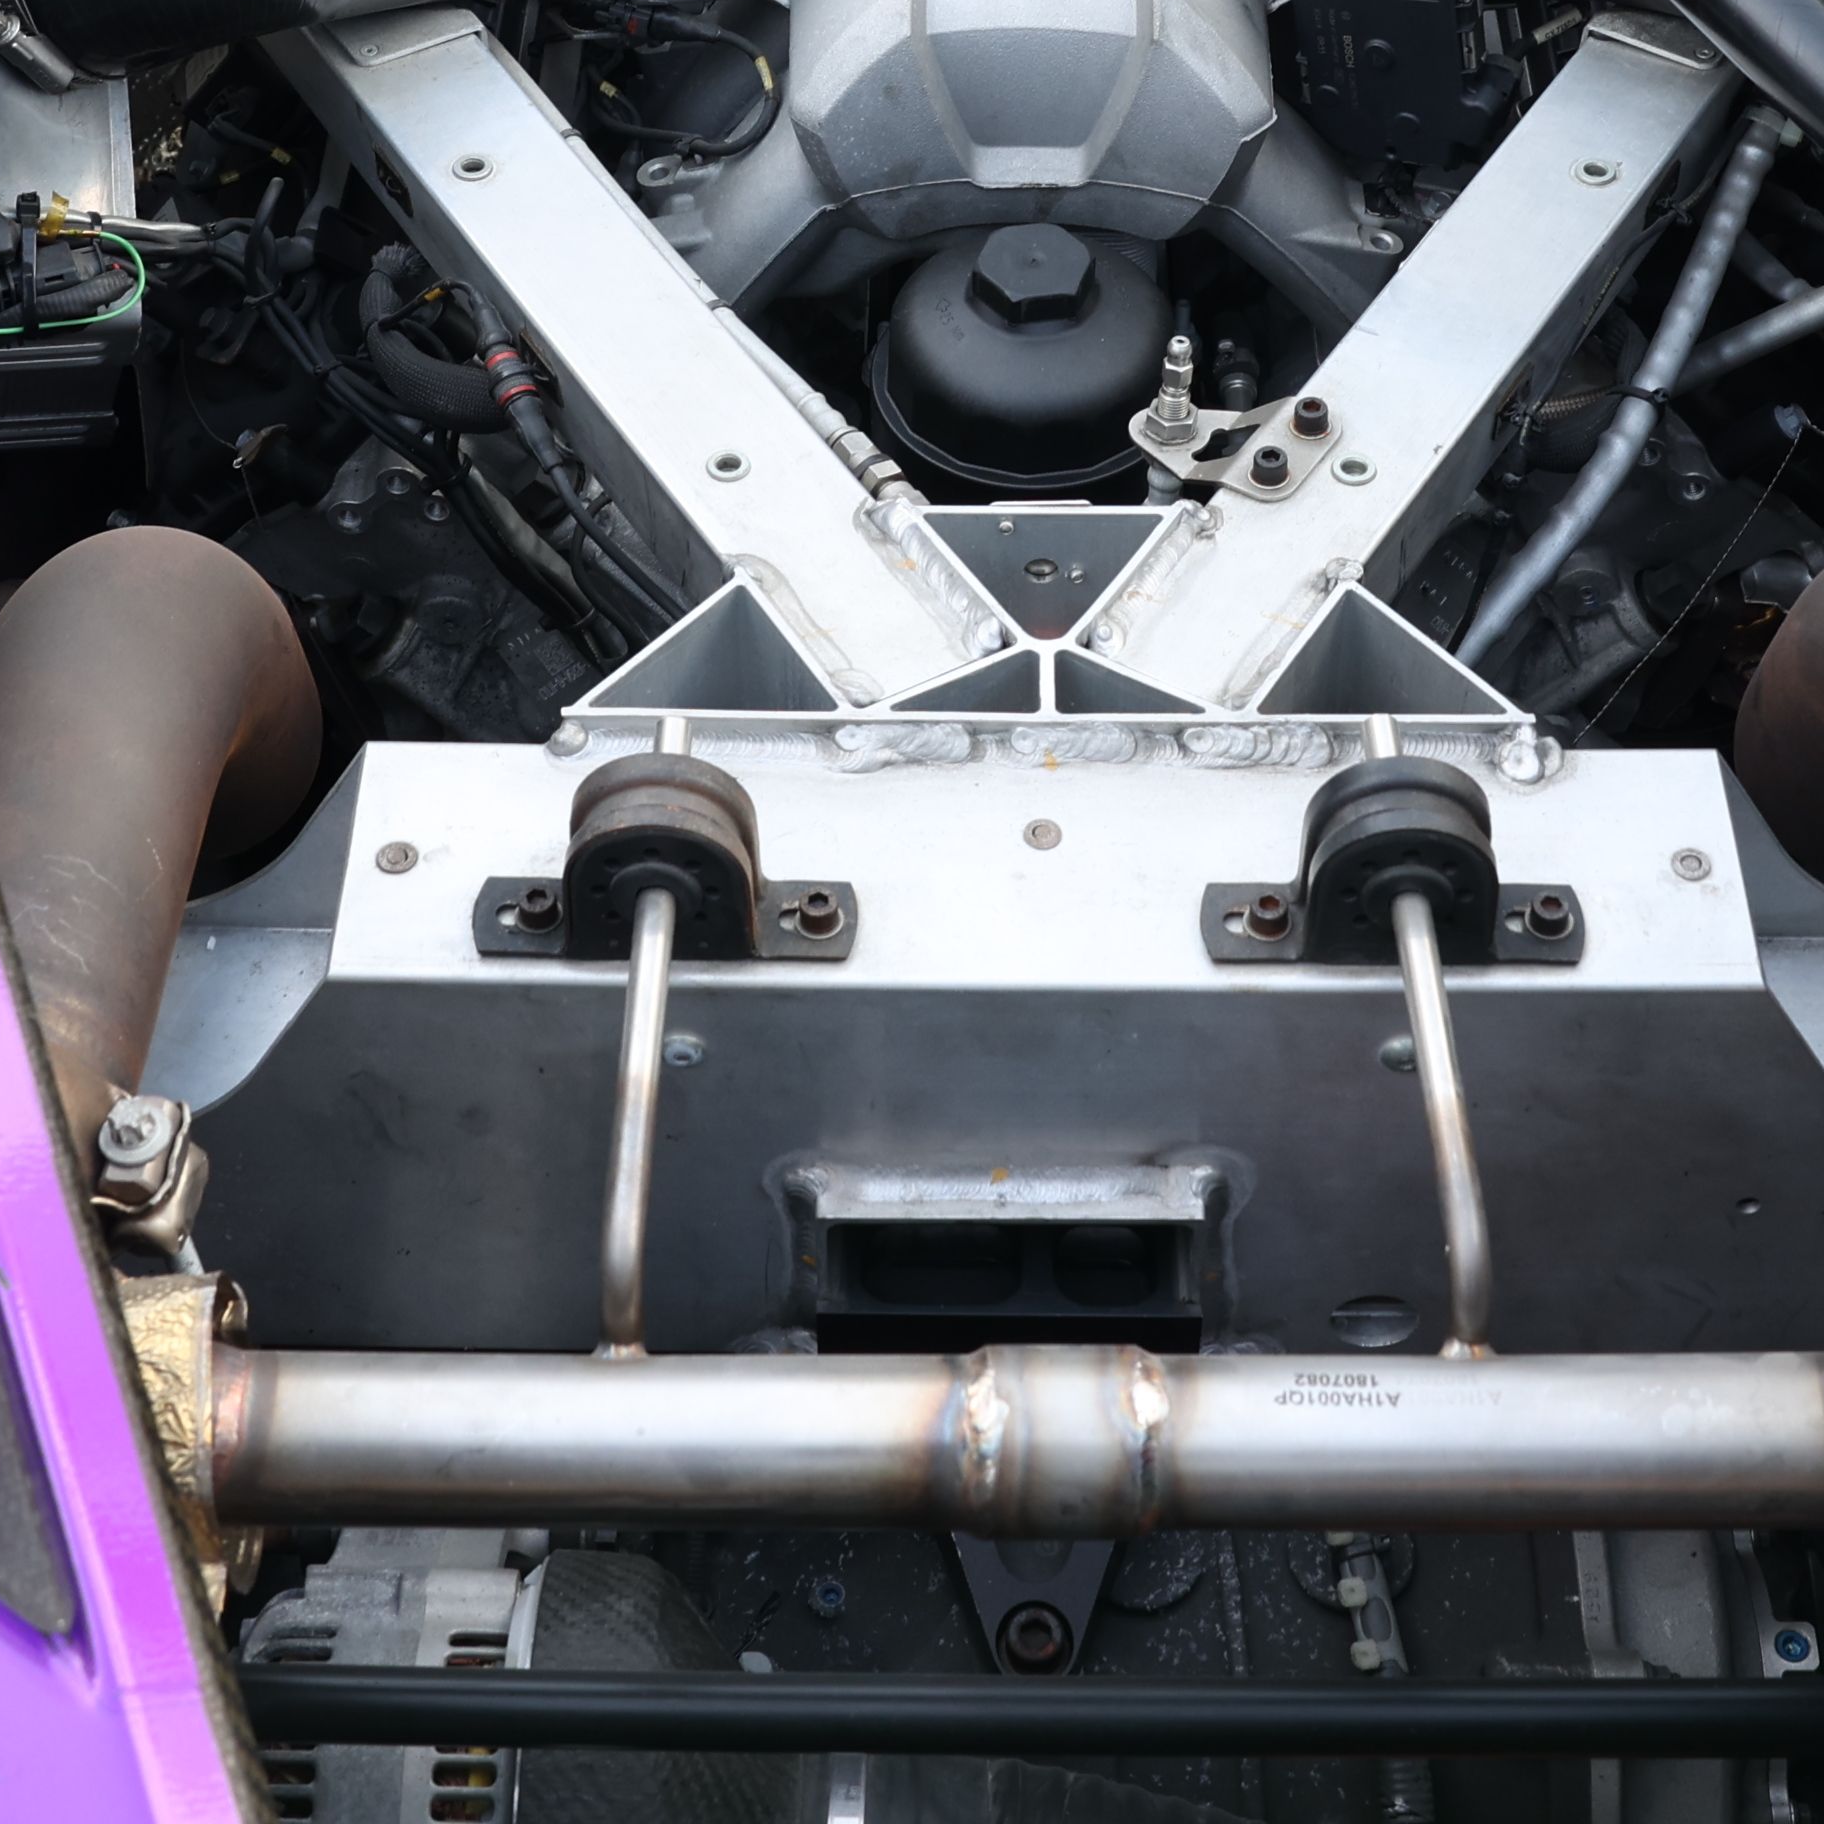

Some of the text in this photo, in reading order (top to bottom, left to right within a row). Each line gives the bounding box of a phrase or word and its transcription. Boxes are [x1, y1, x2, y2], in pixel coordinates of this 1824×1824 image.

[1343, 35, 1355, 68] BOSCH
[1294, 1373, 1379, 1388] 1807082
[1275, 1389, 1401, 1407] A1HA001QP
